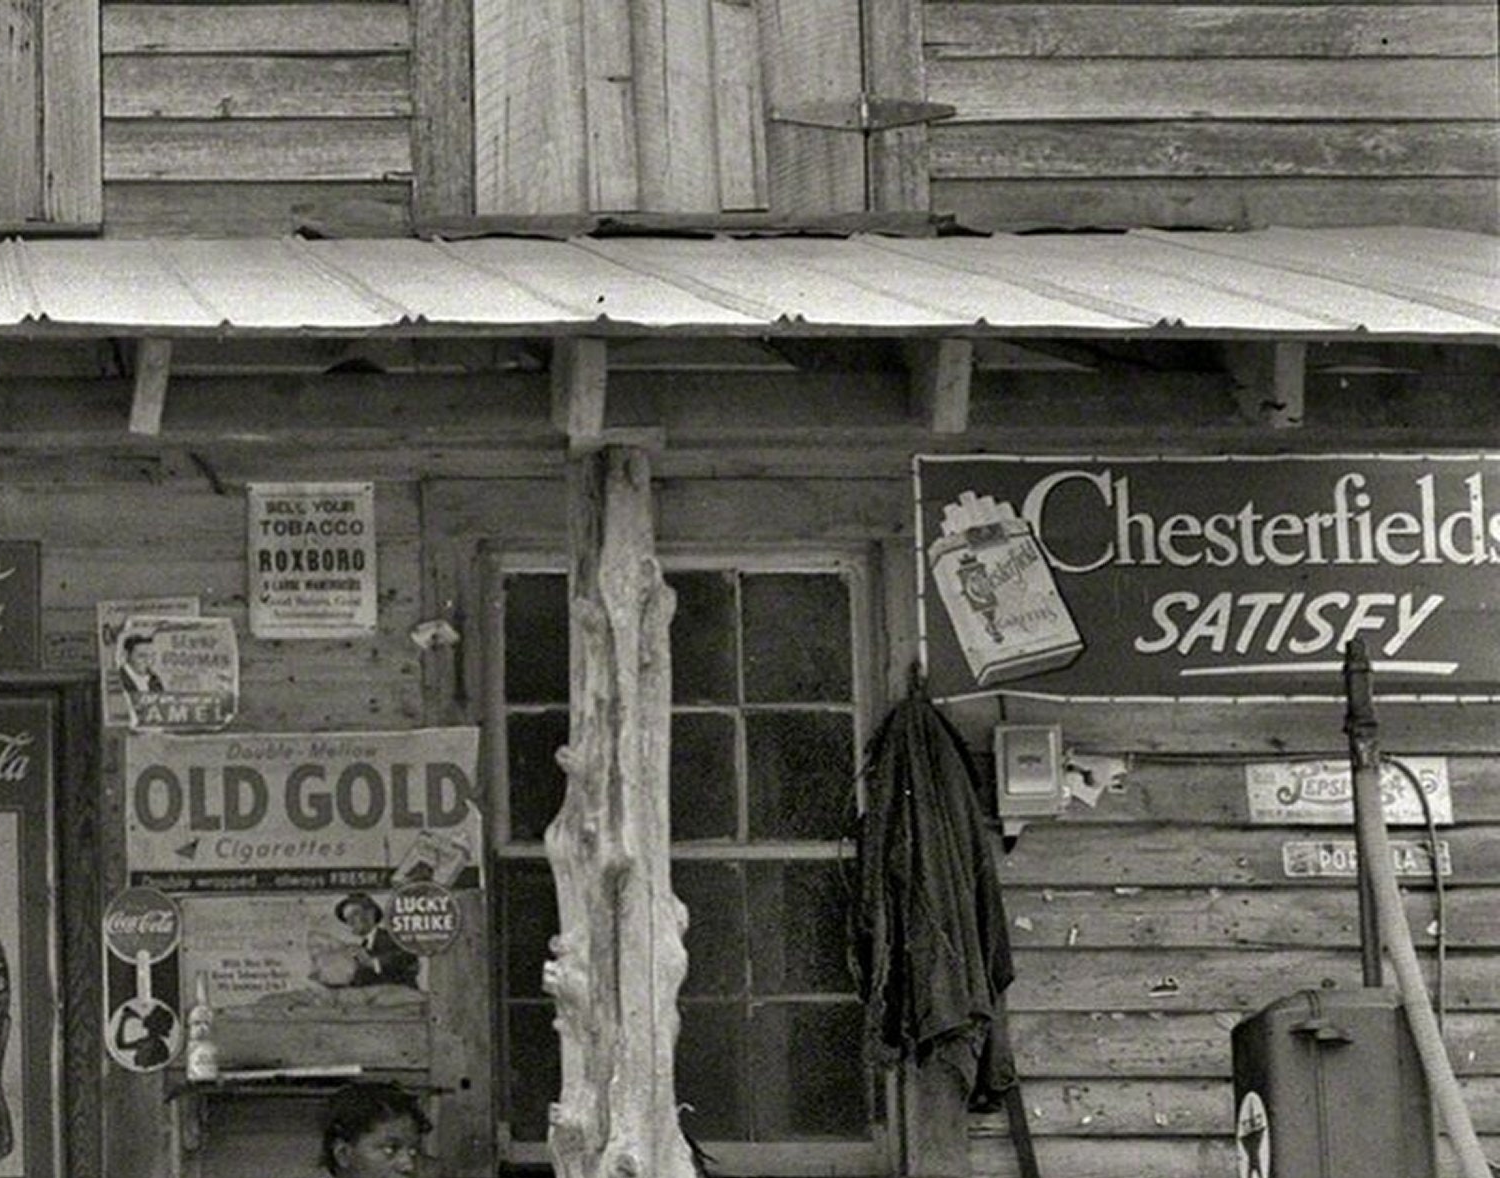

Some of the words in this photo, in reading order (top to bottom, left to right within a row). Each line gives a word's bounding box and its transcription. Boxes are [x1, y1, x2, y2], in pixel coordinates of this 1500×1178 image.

[260, 519, 364, 536] TOBACCO
[259, 549, 365, 573] ROXBORO
[1134, 592, 1444, 657] SATISFY
[134, 764, 268, 831] OLD
[285, 762, 470, 831] GOLD
[214, 838, 345, 863] Cigarettes
[395, 897, 449, 913] LUCKY
[107, 910, 174, 933] Coca-Cola
[393, 915, 454, 932] STRIKE
